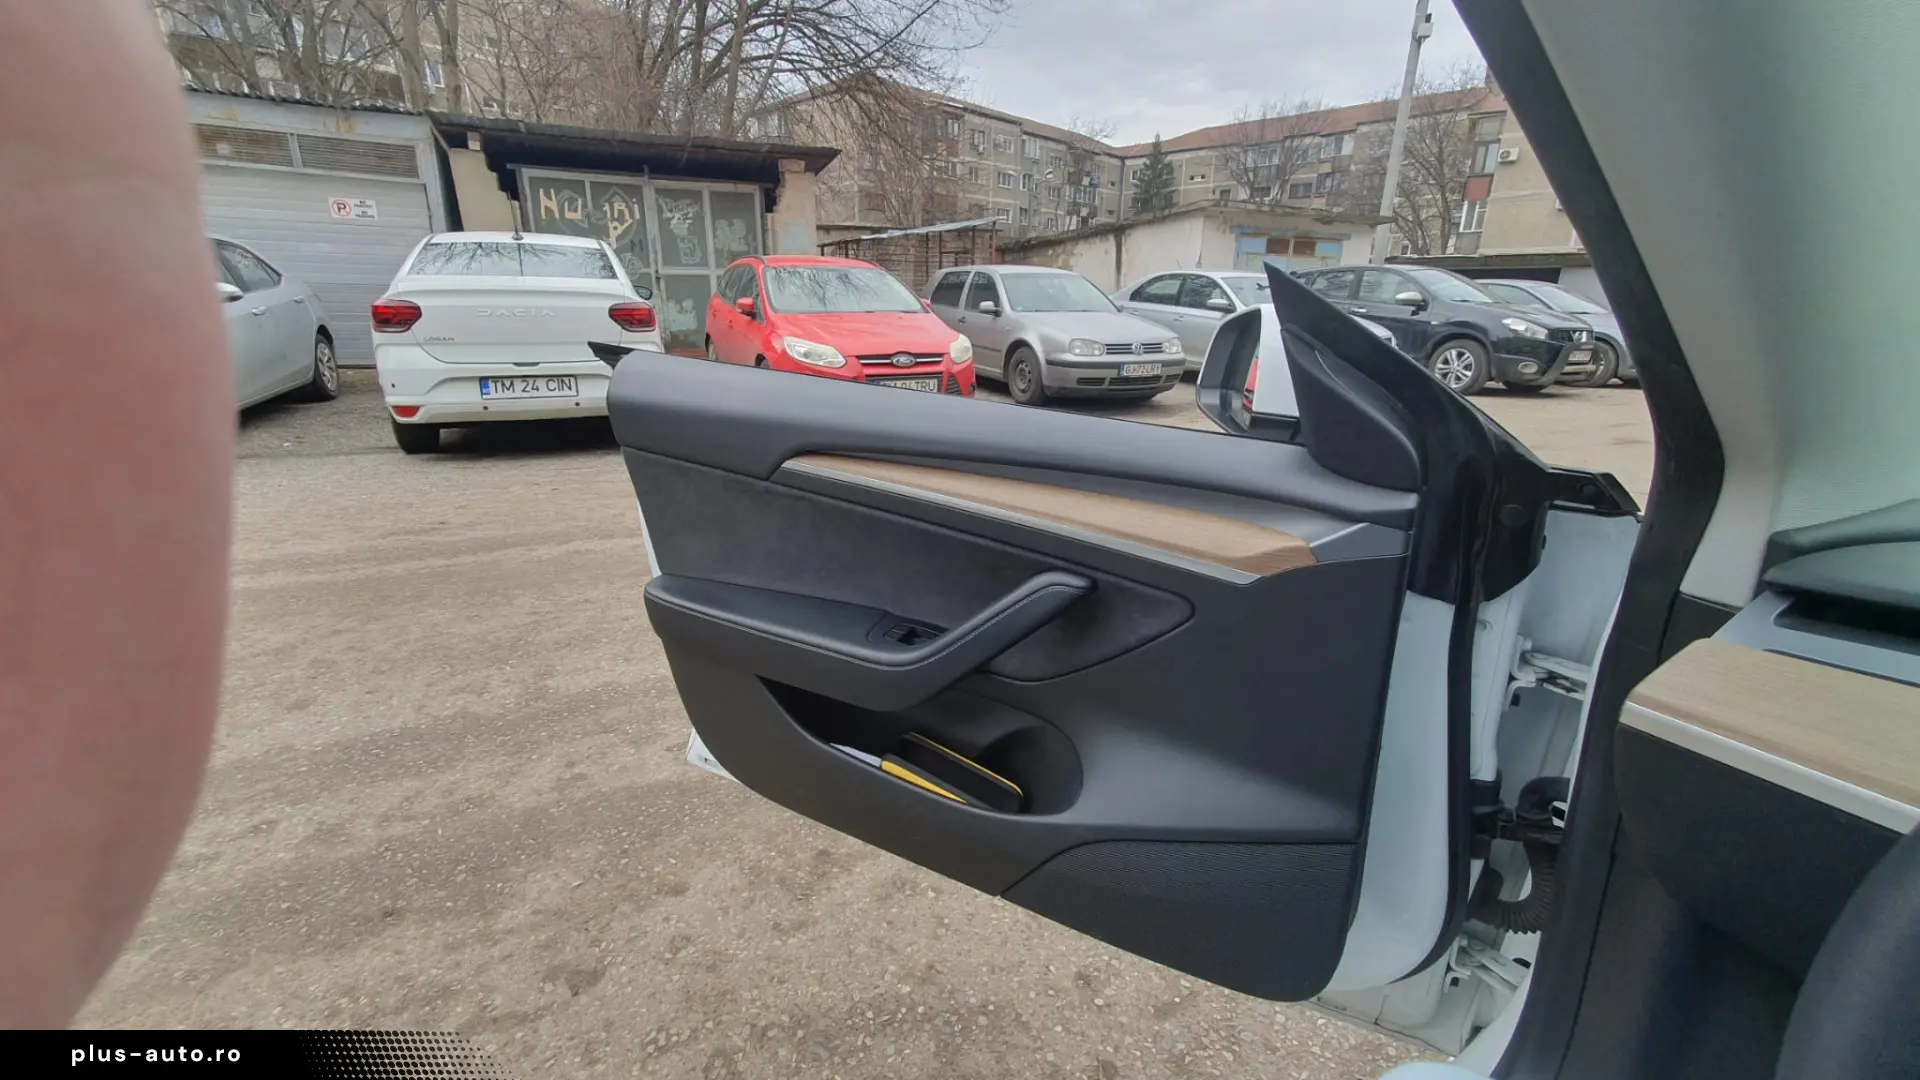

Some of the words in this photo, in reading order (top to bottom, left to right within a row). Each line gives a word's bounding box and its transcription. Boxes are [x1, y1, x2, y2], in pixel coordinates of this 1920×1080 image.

[476, 308, 555, 316] DACIA
[491, 379, 515, 393] TM
[521, 379, 540, 392] 24
[545, 377, 572, 391] CIN
